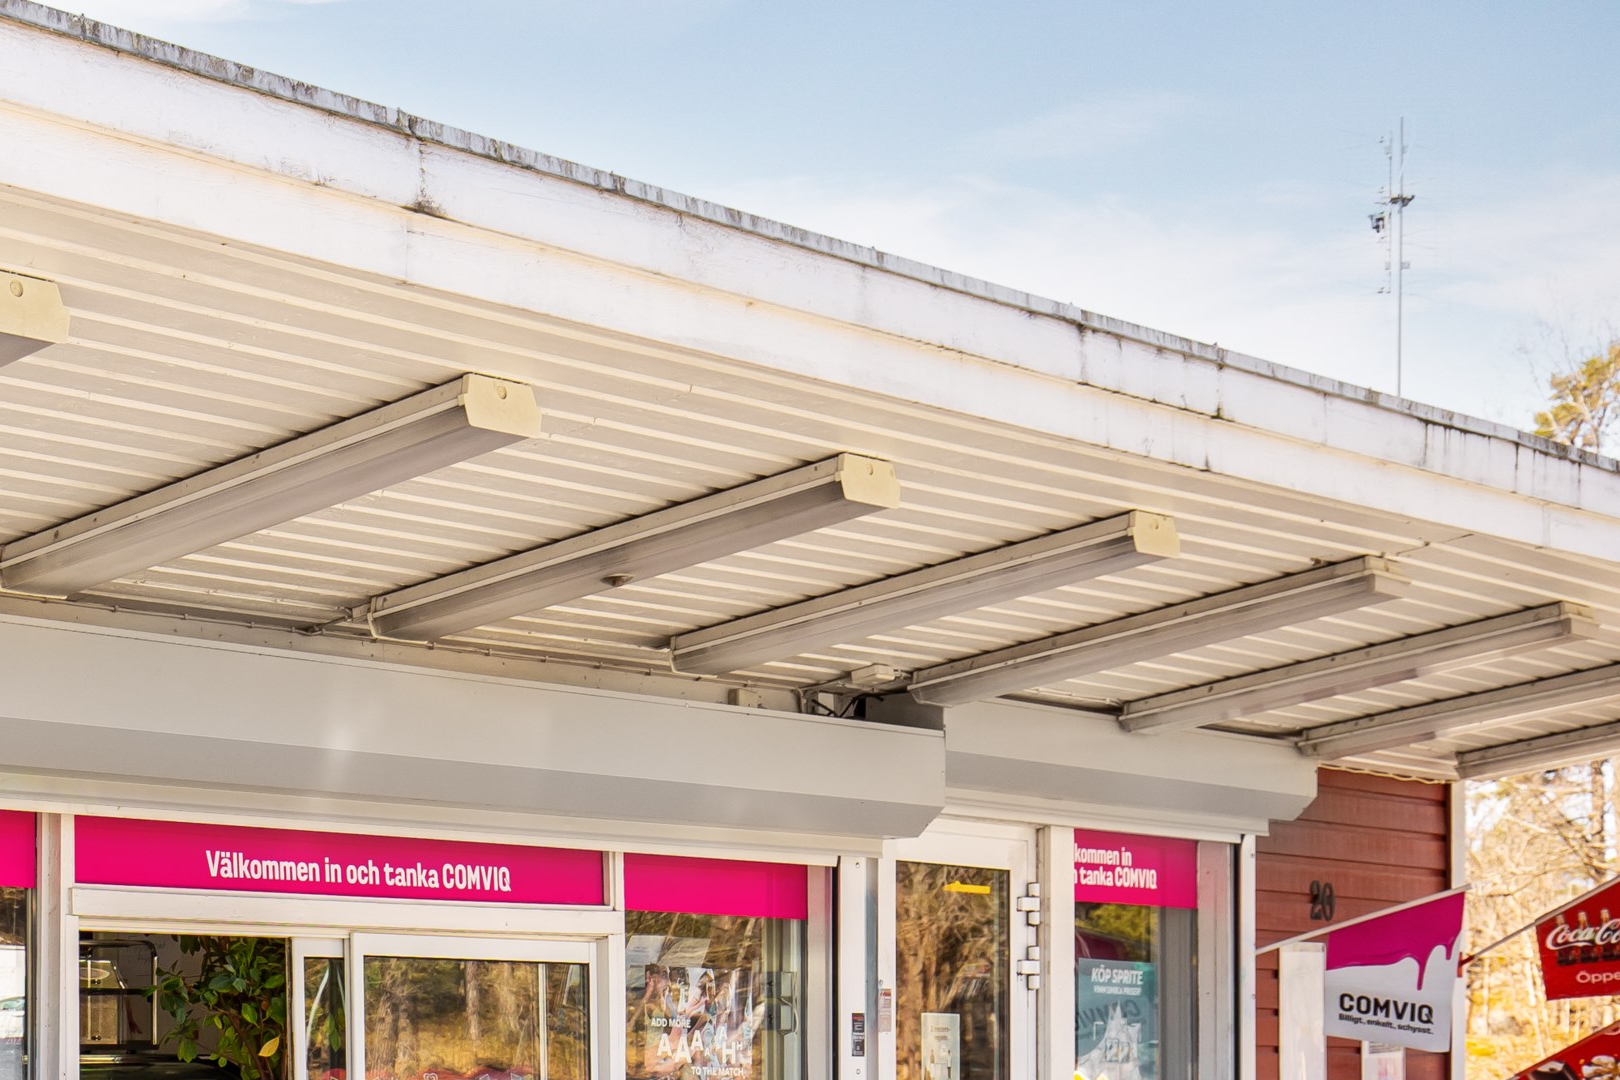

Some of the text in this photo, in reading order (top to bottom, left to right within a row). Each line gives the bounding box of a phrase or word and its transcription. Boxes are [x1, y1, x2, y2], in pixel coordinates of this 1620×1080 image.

[1122, 847, 1132, 866] in
[205, 850, 512, 893] Välkommen in och tanka COMVIQ
[1080, 867, 1158, 889] tanka COMVIQ
[1310, 880, 1335, 921] 20
[1091, 964, 1144, 985] KÖP SPRITE
[1339, 993, 1434, 1025] COMVIQ
[651, 1018, 691, 1029] ADD MORE
[691, 1067, 744, 1076] TO THE MATCH
